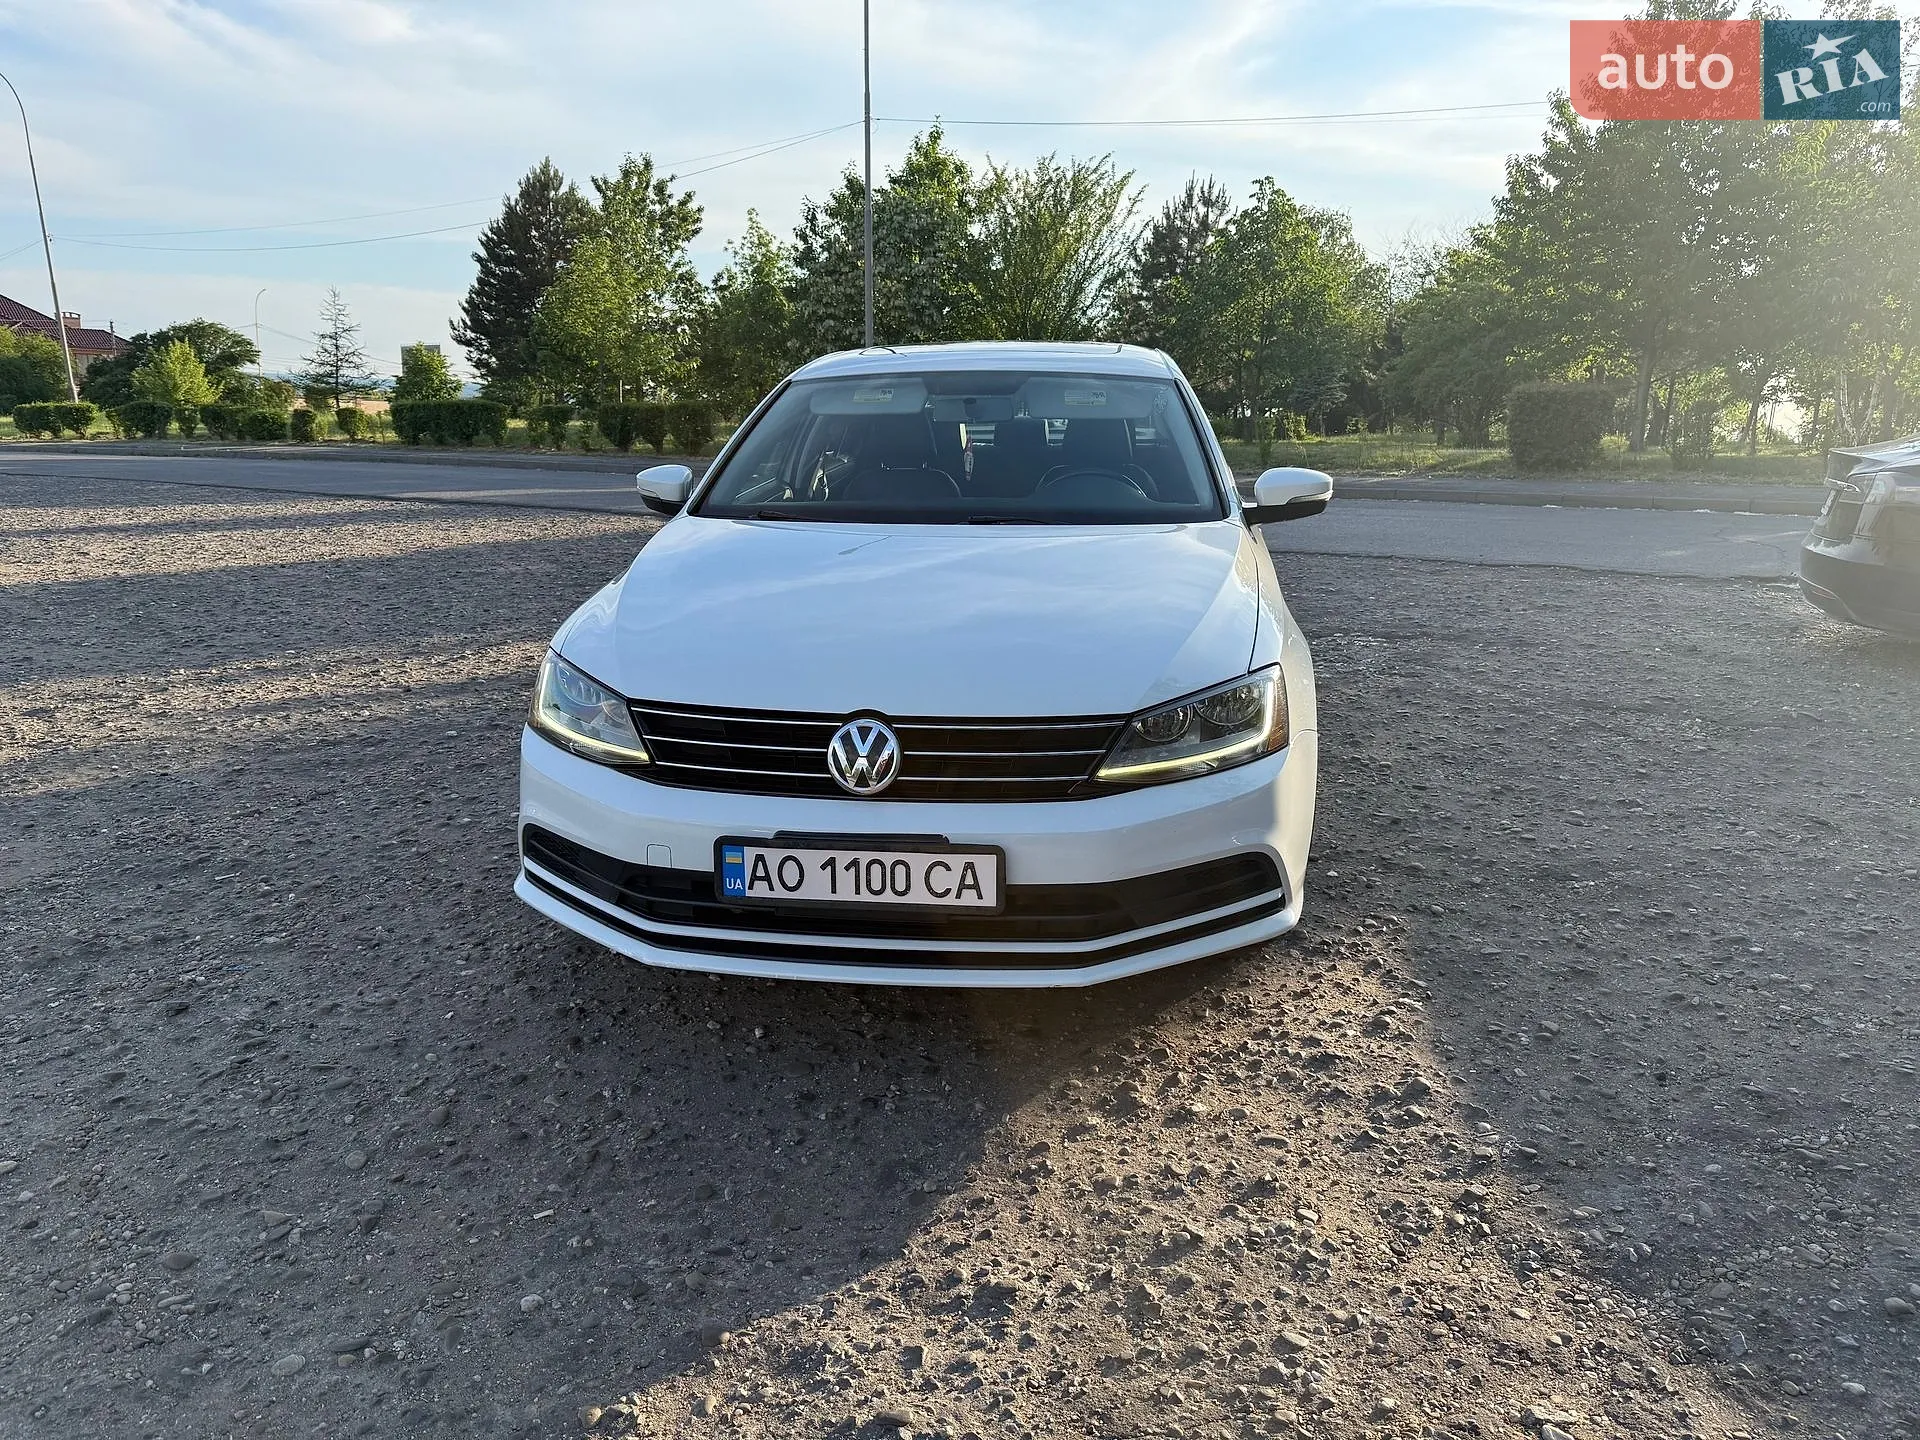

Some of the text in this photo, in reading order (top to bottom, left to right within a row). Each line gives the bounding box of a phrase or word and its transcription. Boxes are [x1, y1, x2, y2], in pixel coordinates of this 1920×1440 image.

[726, 877, 743, 890] UA
[747, 853, 984, 900] AO 1100 CA
